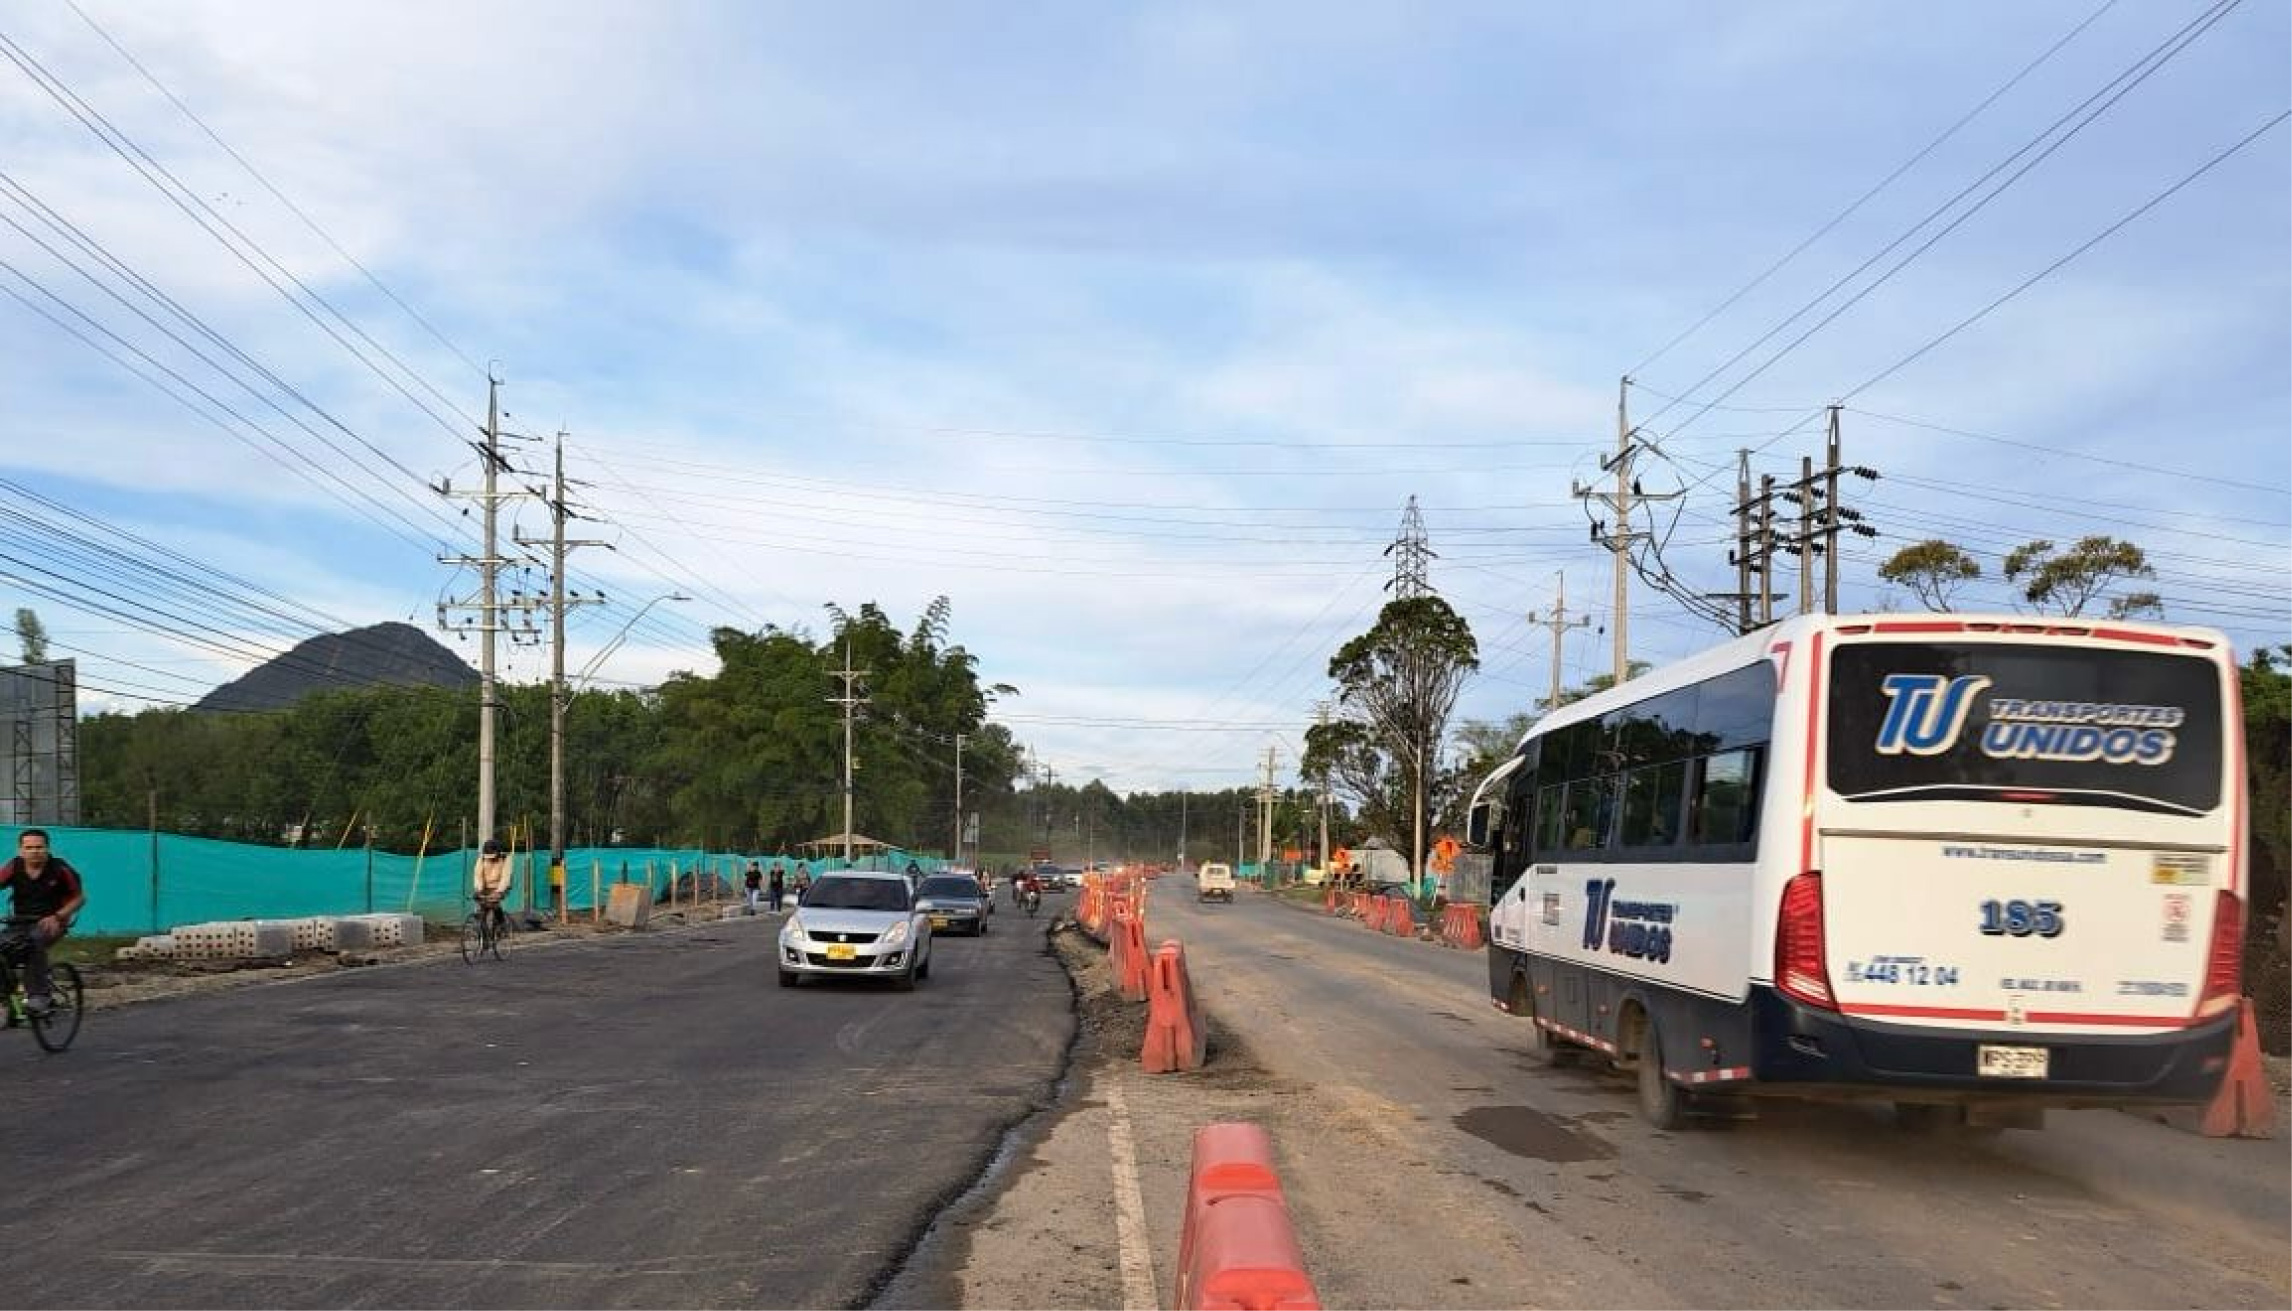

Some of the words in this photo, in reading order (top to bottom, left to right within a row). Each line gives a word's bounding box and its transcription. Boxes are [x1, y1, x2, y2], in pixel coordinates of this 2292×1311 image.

[1875, 674, 1993, 756] TU
[1989, 699, 2186, 727] TRANSPORTES
[1981, 722, 2177, 765] UNIDOS
[1979, 900, 2064, 938] 185
[1864, 963, 1900, 984] 448
[1907, 966, 1931, 986] 12
[1934, 966, 1960, 986] 04
